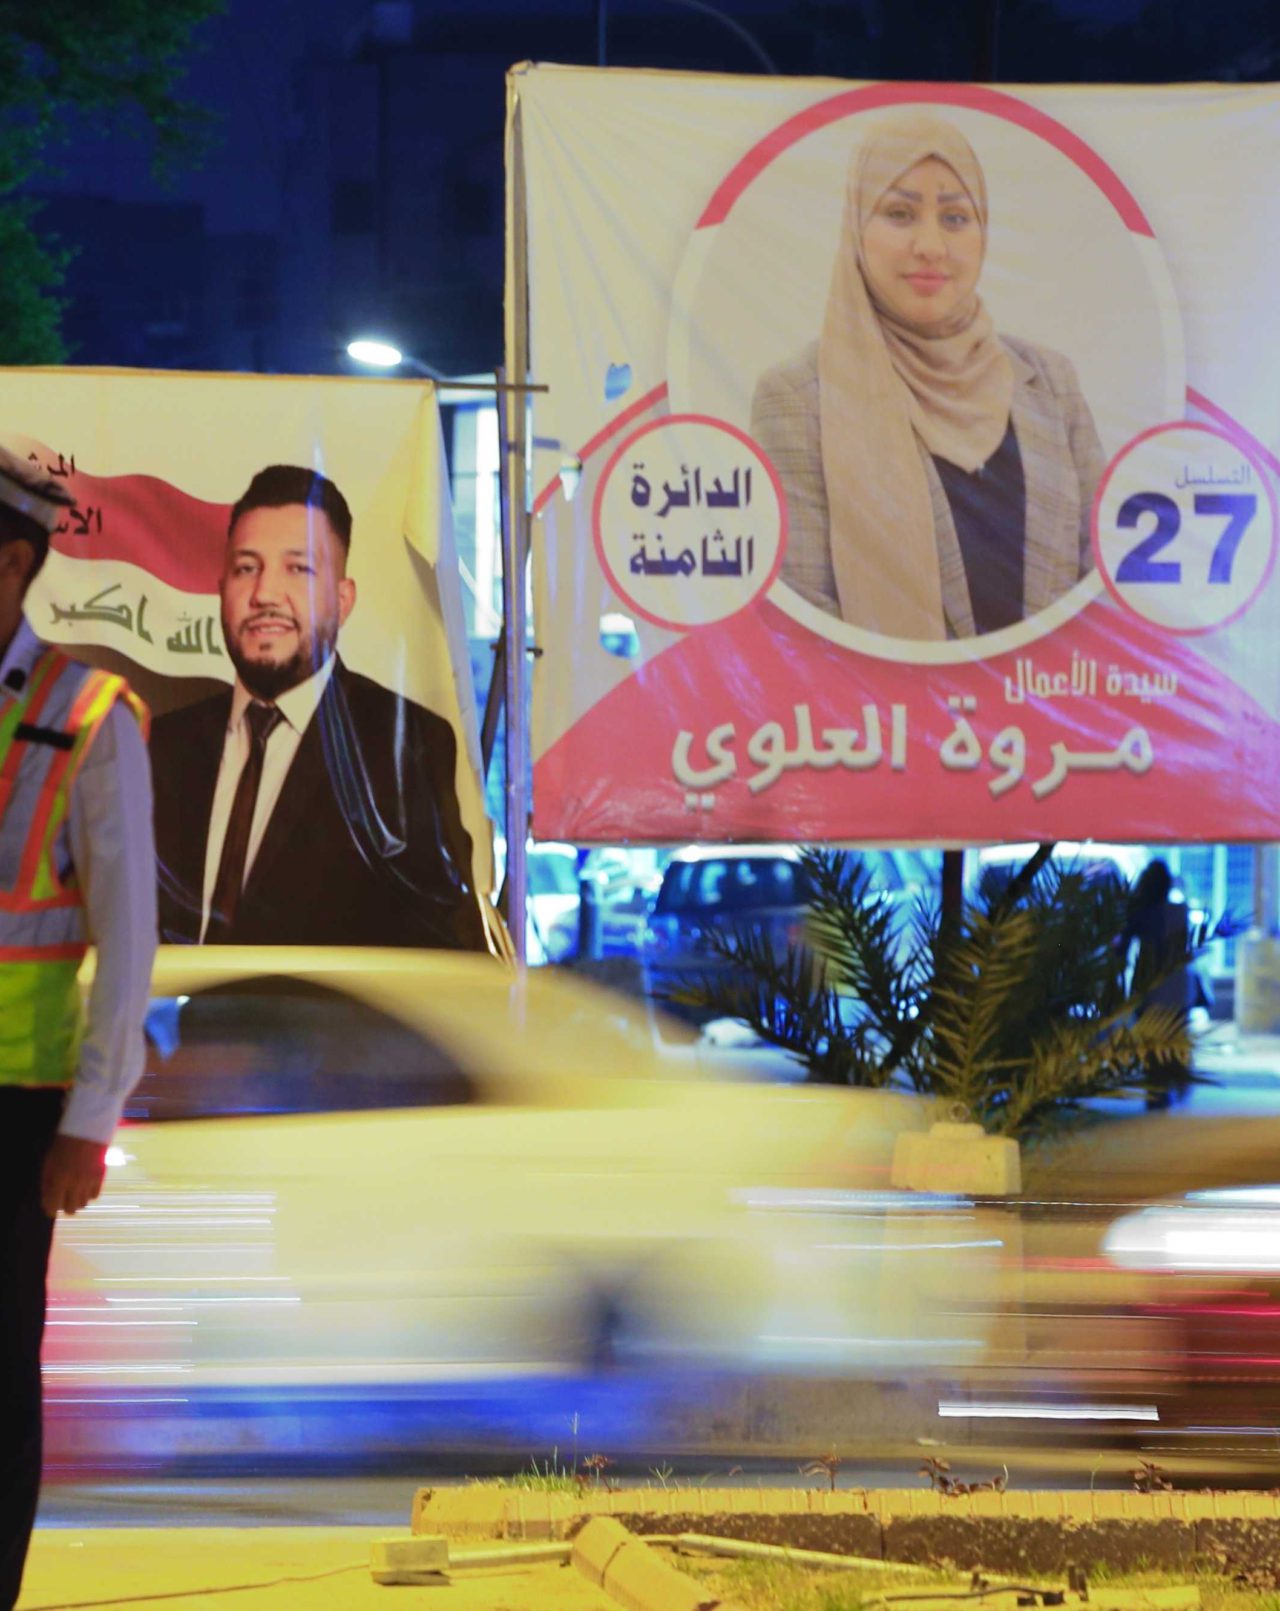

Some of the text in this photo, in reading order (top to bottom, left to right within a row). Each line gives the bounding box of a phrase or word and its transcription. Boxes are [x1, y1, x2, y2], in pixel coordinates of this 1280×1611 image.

[631, 462, 752, 518] الدائرة
[1175, 464, 1251, 489] التسلسل
[630, 529, 753, 577] الثامنة
[1115, 491, 1258, 584] 27
[1005, 650, 1178, 704] سيدة الأعمال
[672, 703, 908, 812] العلوي
